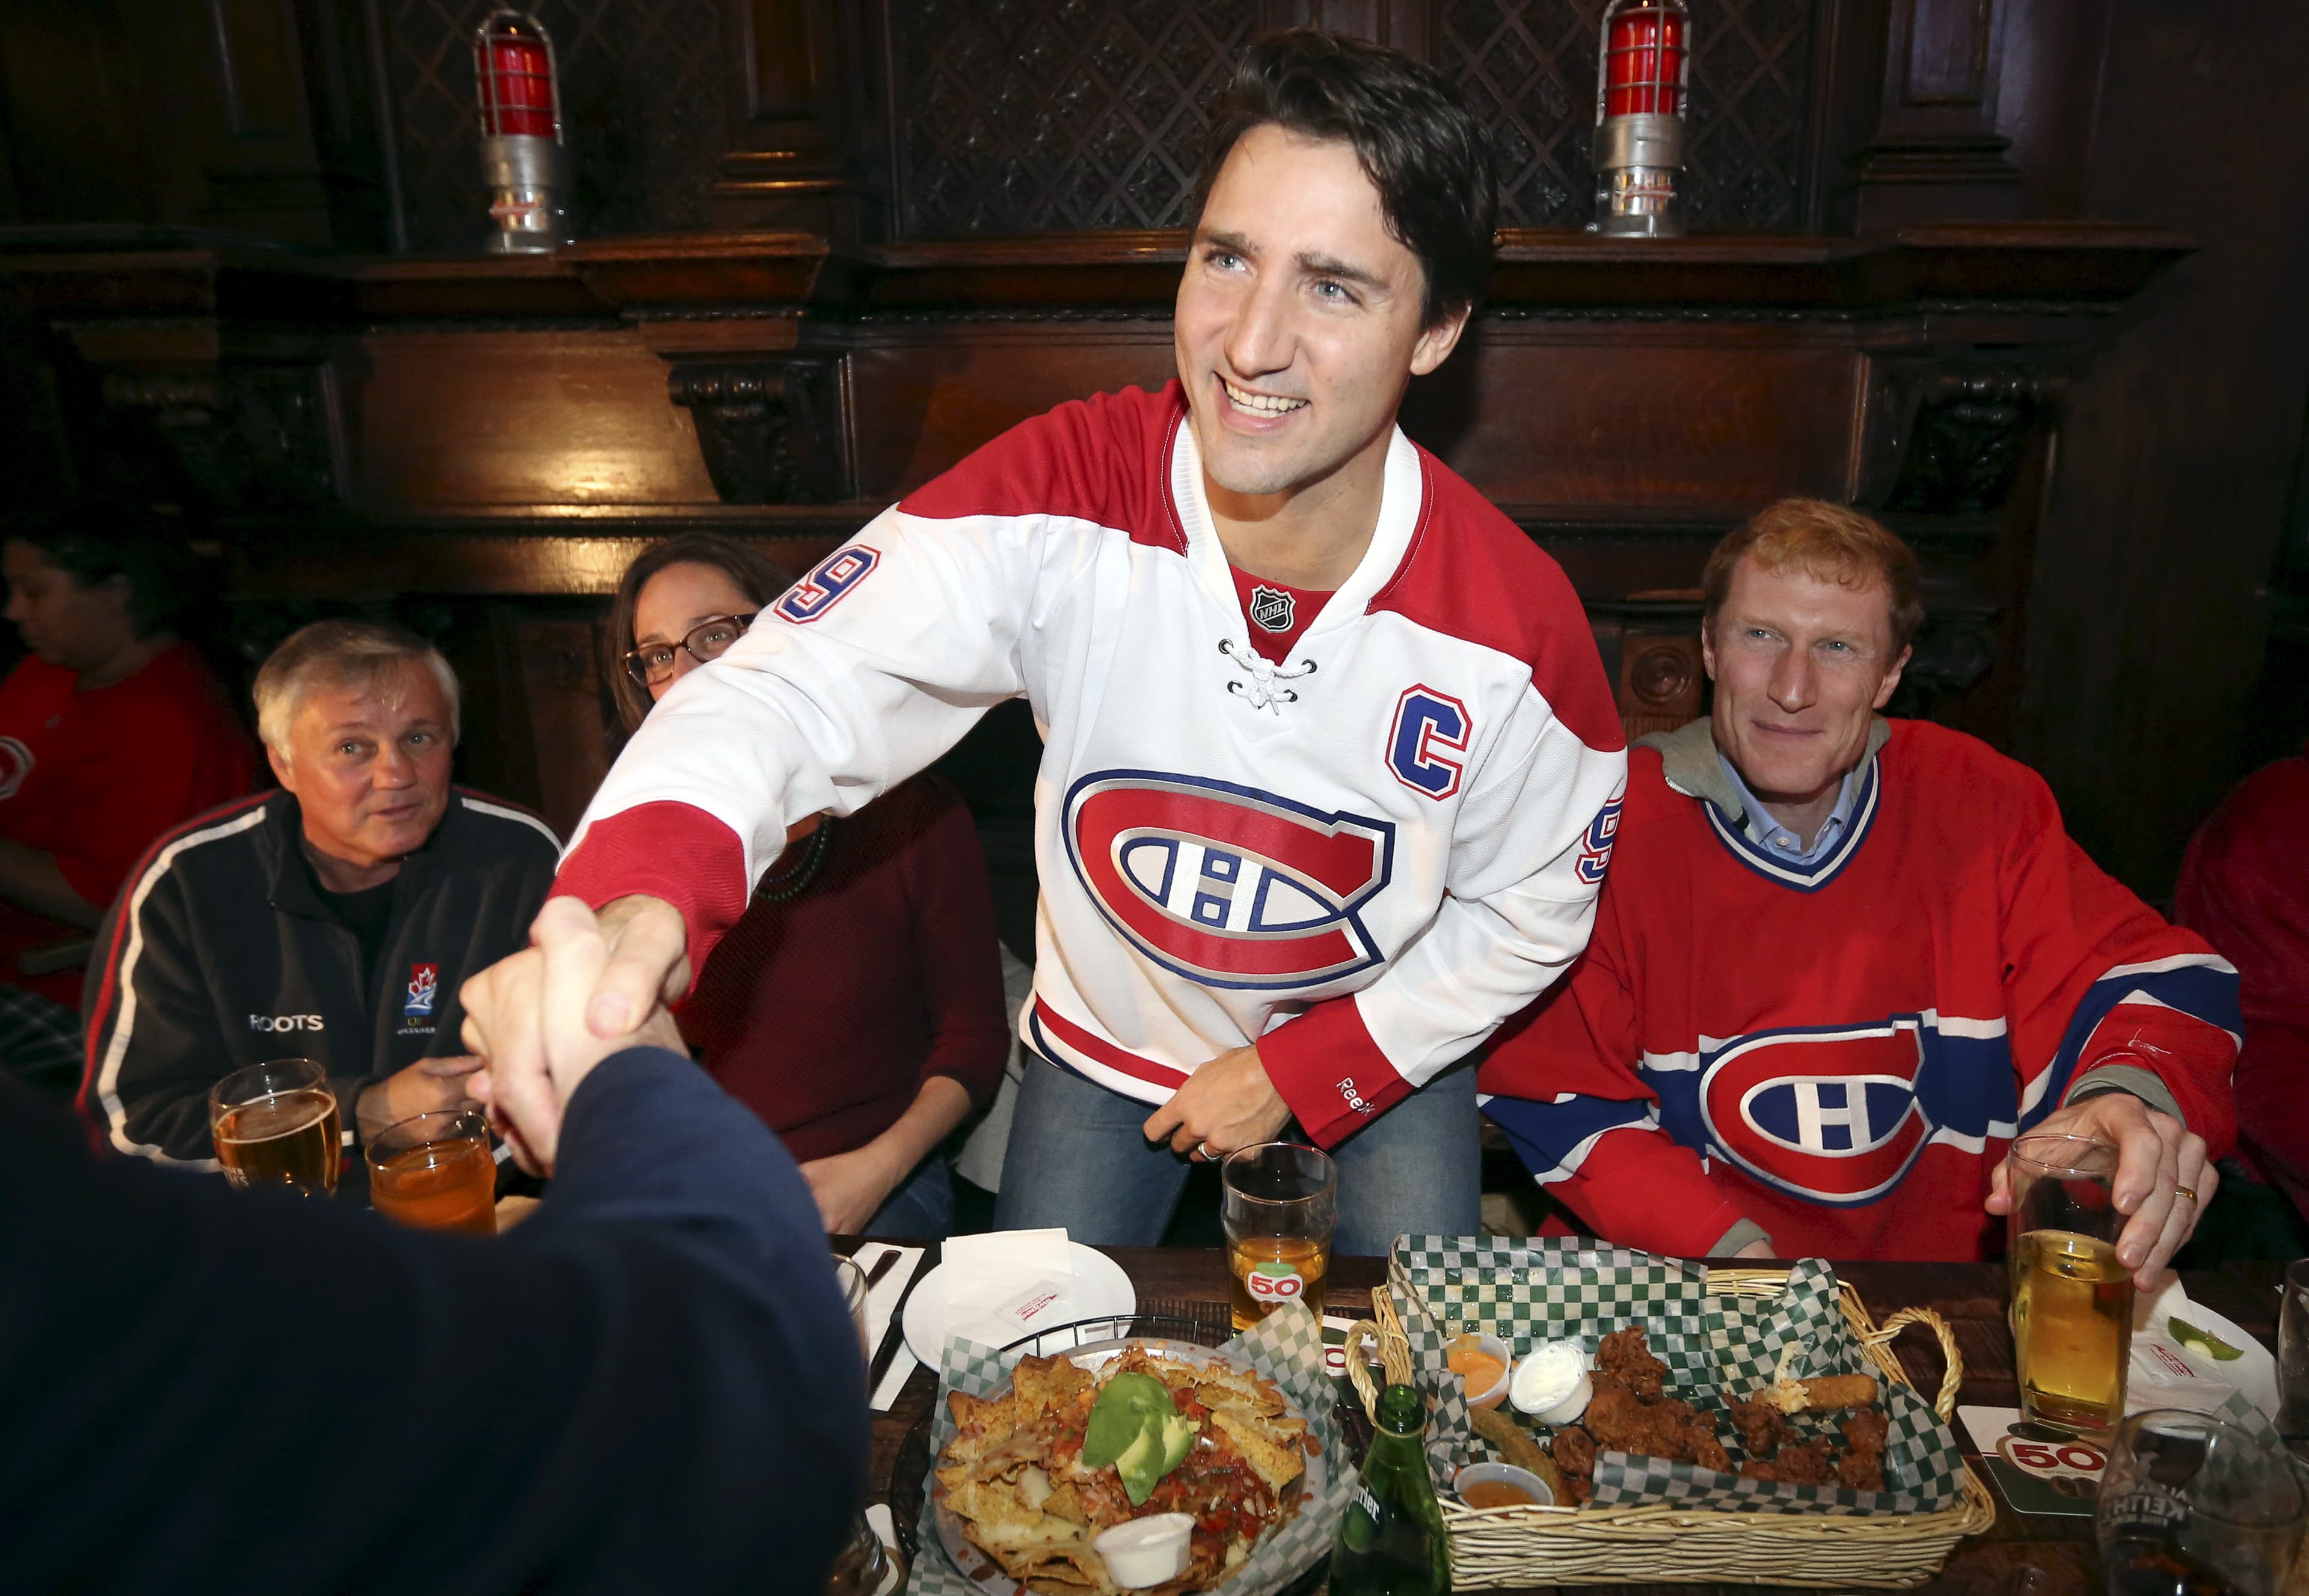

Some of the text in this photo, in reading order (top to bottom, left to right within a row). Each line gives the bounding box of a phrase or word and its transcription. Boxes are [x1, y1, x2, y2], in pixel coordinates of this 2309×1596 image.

[774, 543, 882, 625] 9
[1260, 602, 1284, 620] NHL
[1385, 682, 1473, 802] C
[249, 1014, 324, 1032] ROOTS
[1251, 1275, 1300, 1296] 50
[2012, 1444, 2106, 1471] 50
[1347, 1485, 1380, 1521] rrier
